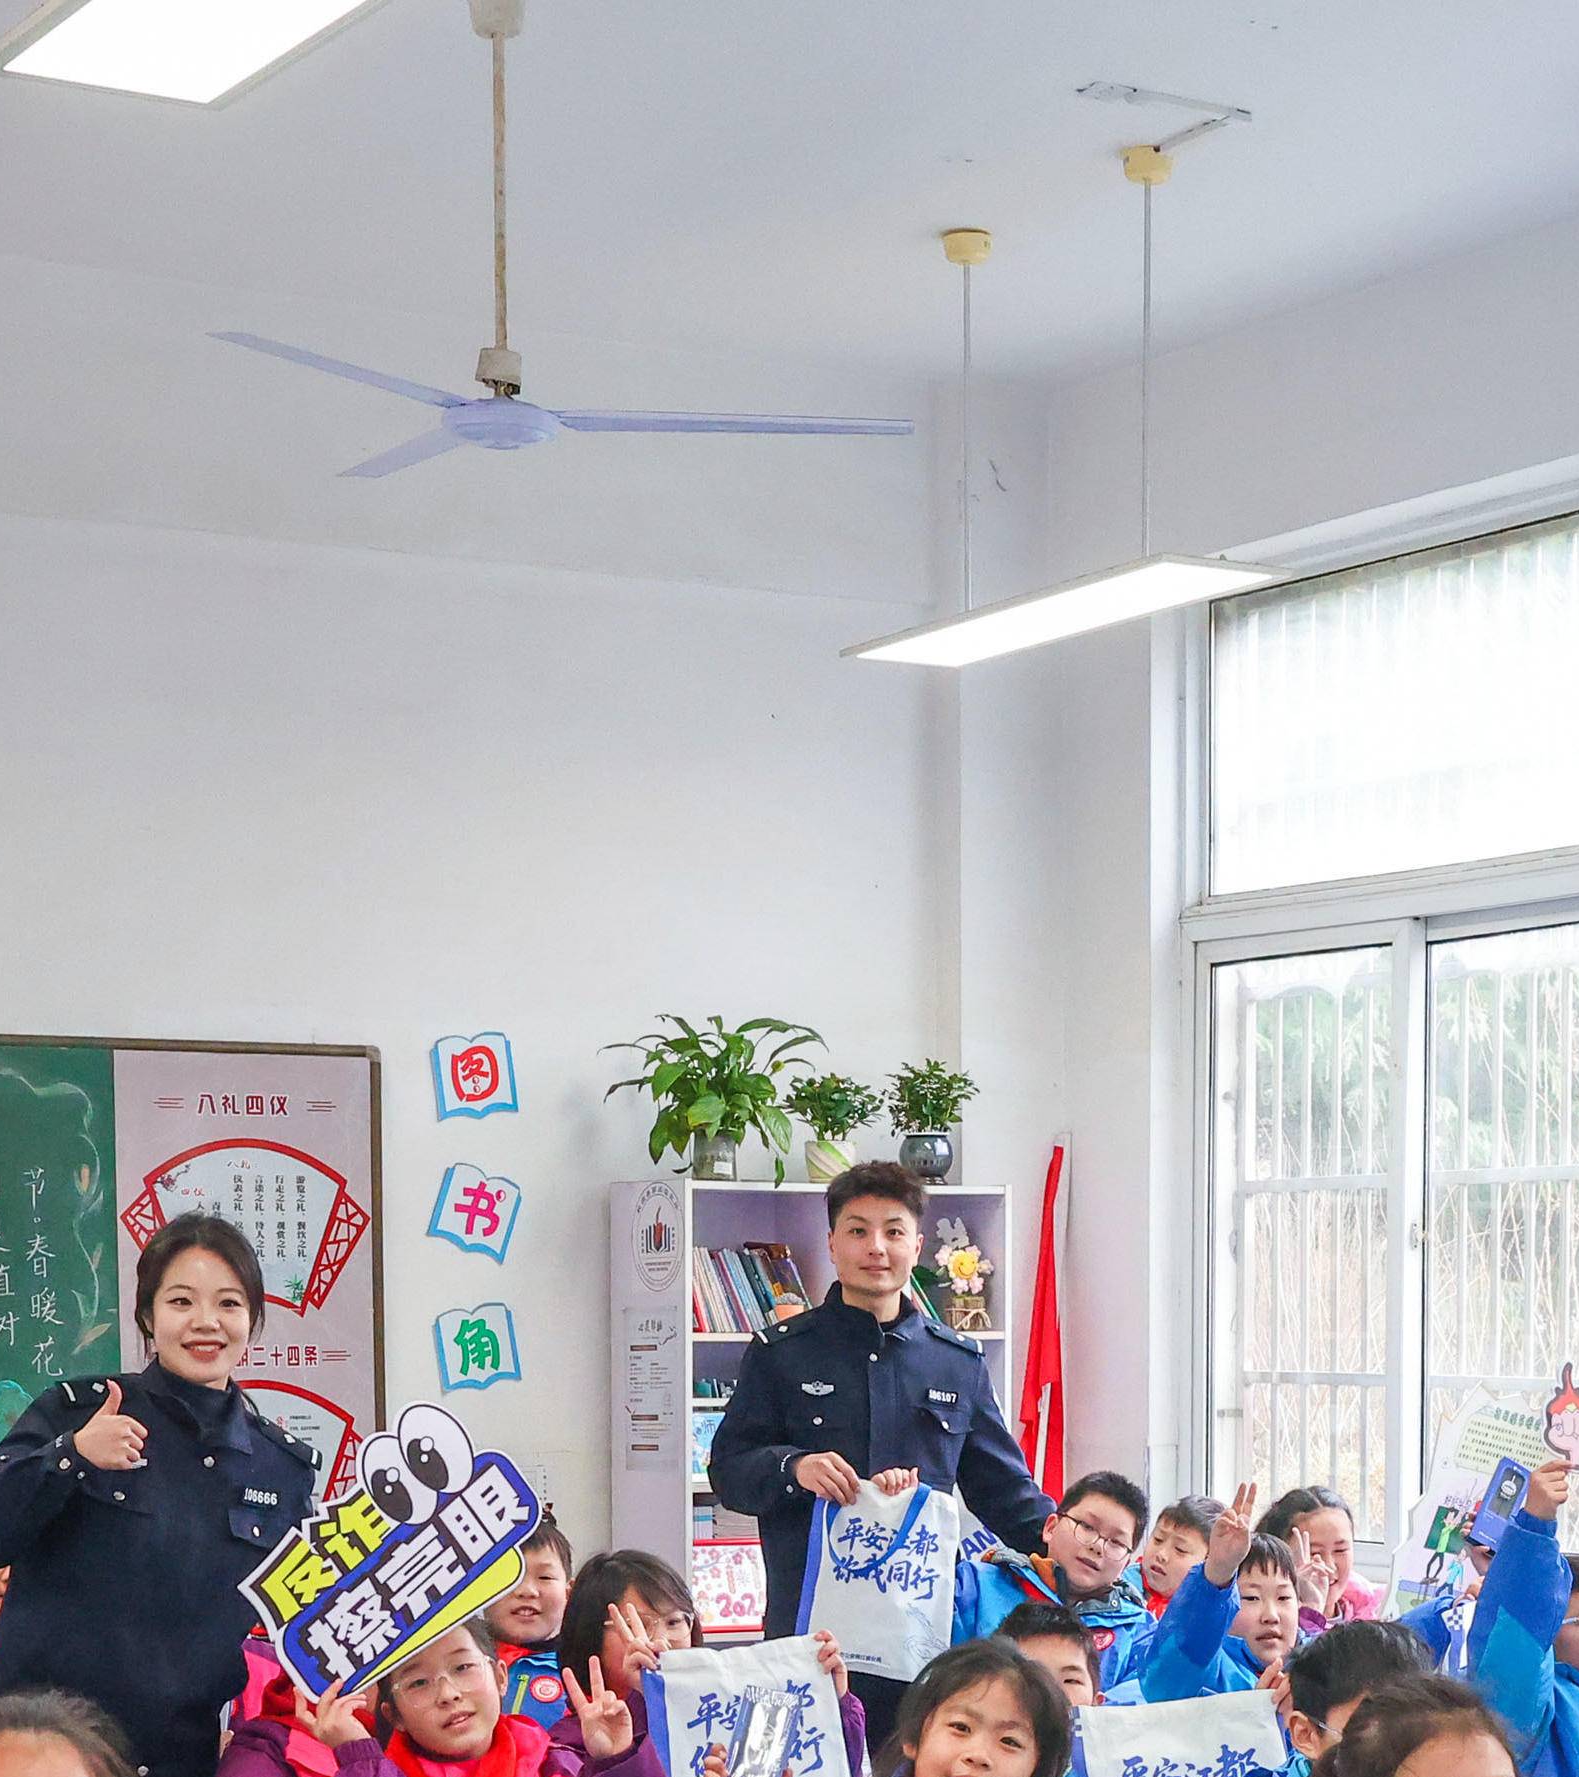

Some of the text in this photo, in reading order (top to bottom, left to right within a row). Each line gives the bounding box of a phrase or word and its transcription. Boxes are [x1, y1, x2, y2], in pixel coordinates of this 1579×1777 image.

[197, 1093, 290, 1118] 八礼四仪
[451, 1046, 507, 1376] 图 书 角
[260, 1489, 392, 1623] 反诈
[307, 1464, 531, 1682] 擦亮眼
